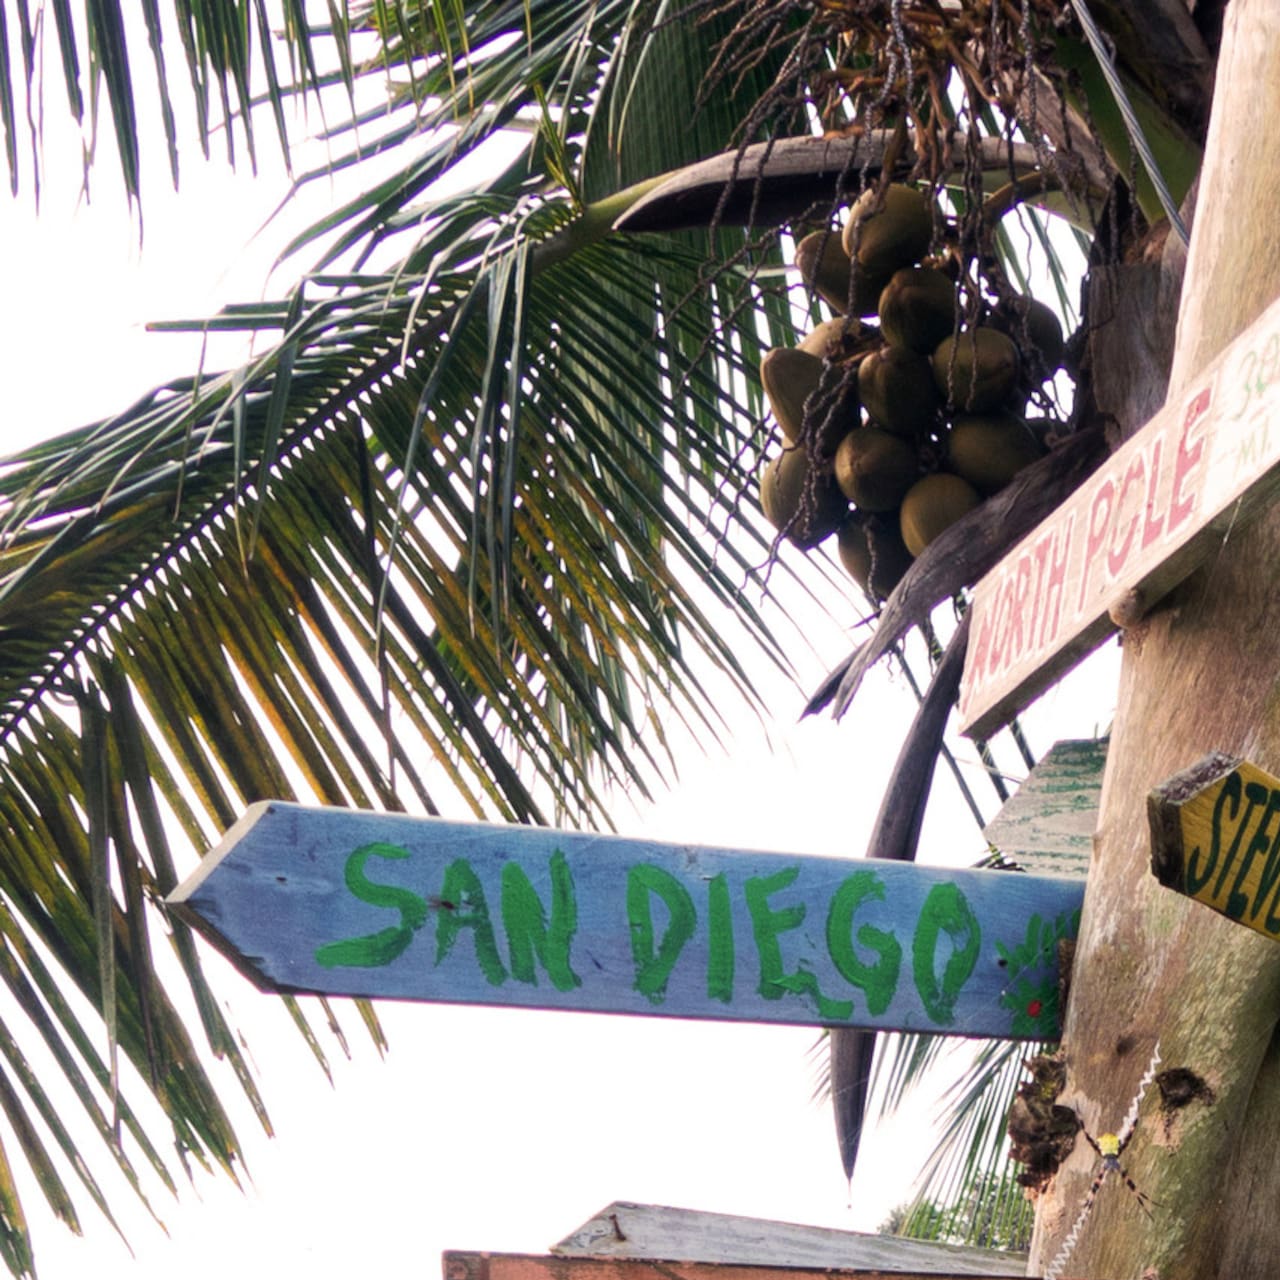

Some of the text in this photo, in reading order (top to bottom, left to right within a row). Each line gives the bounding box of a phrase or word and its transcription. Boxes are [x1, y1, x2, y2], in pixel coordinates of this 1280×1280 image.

[965, 386, 1212, 690] NORTH POLE
[314, 838, 983, 1025] SAN DIEGO
